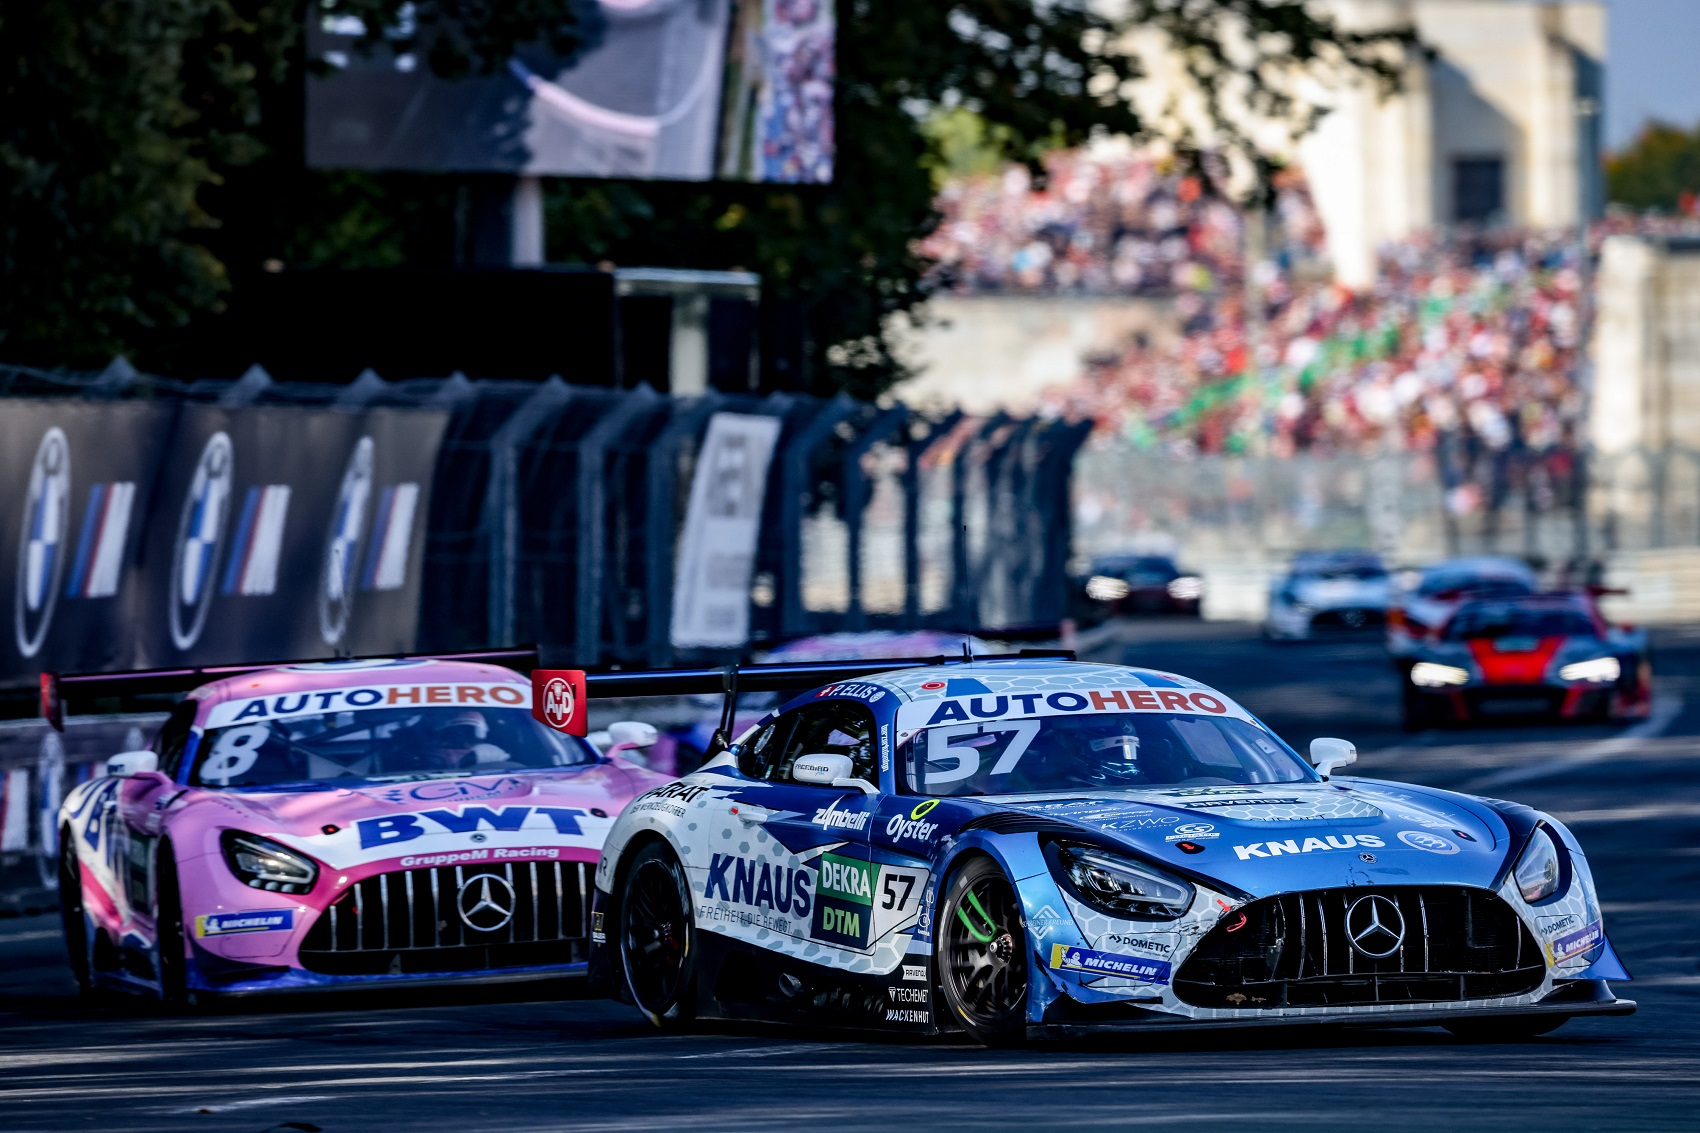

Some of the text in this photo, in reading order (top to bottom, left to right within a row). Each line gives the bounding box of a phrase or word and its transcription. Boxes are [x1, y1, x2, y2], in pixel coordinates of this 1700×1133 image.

[231, 685, 525, 722] AUTOHERO
[925, 690, 1228, 726] AUTOHERO
[199, 724, 271, 781] 8
[924, 719, 1042, 785] 57
[356, 806, 588, 850] BWT
[886, 813, 939, 843] Oyster
[1100, 816, 1180, 830] KZWO
[400, 848, 560, 867] GruppeM Racing
[1232, 834, 1386, 861] KNAUS
[704, 852, 812, 918] KNAUS
[822, 860, 872, 898] DEKRA
[881, 873, 916, 911] 57
[822, 906, 861, 938] DTM
[1548, 915, 1575, 934] DOMETIC
[1122, 936, 1171, 954] DOMETIC
[1566, 929, 1600, 953] MICHELIN
[1083, 957, 1158, 976] MICHELIN
[896, 988, 929, 1003] TECHEMET
[885, 1009, 929, 1024] WACKENHUT
